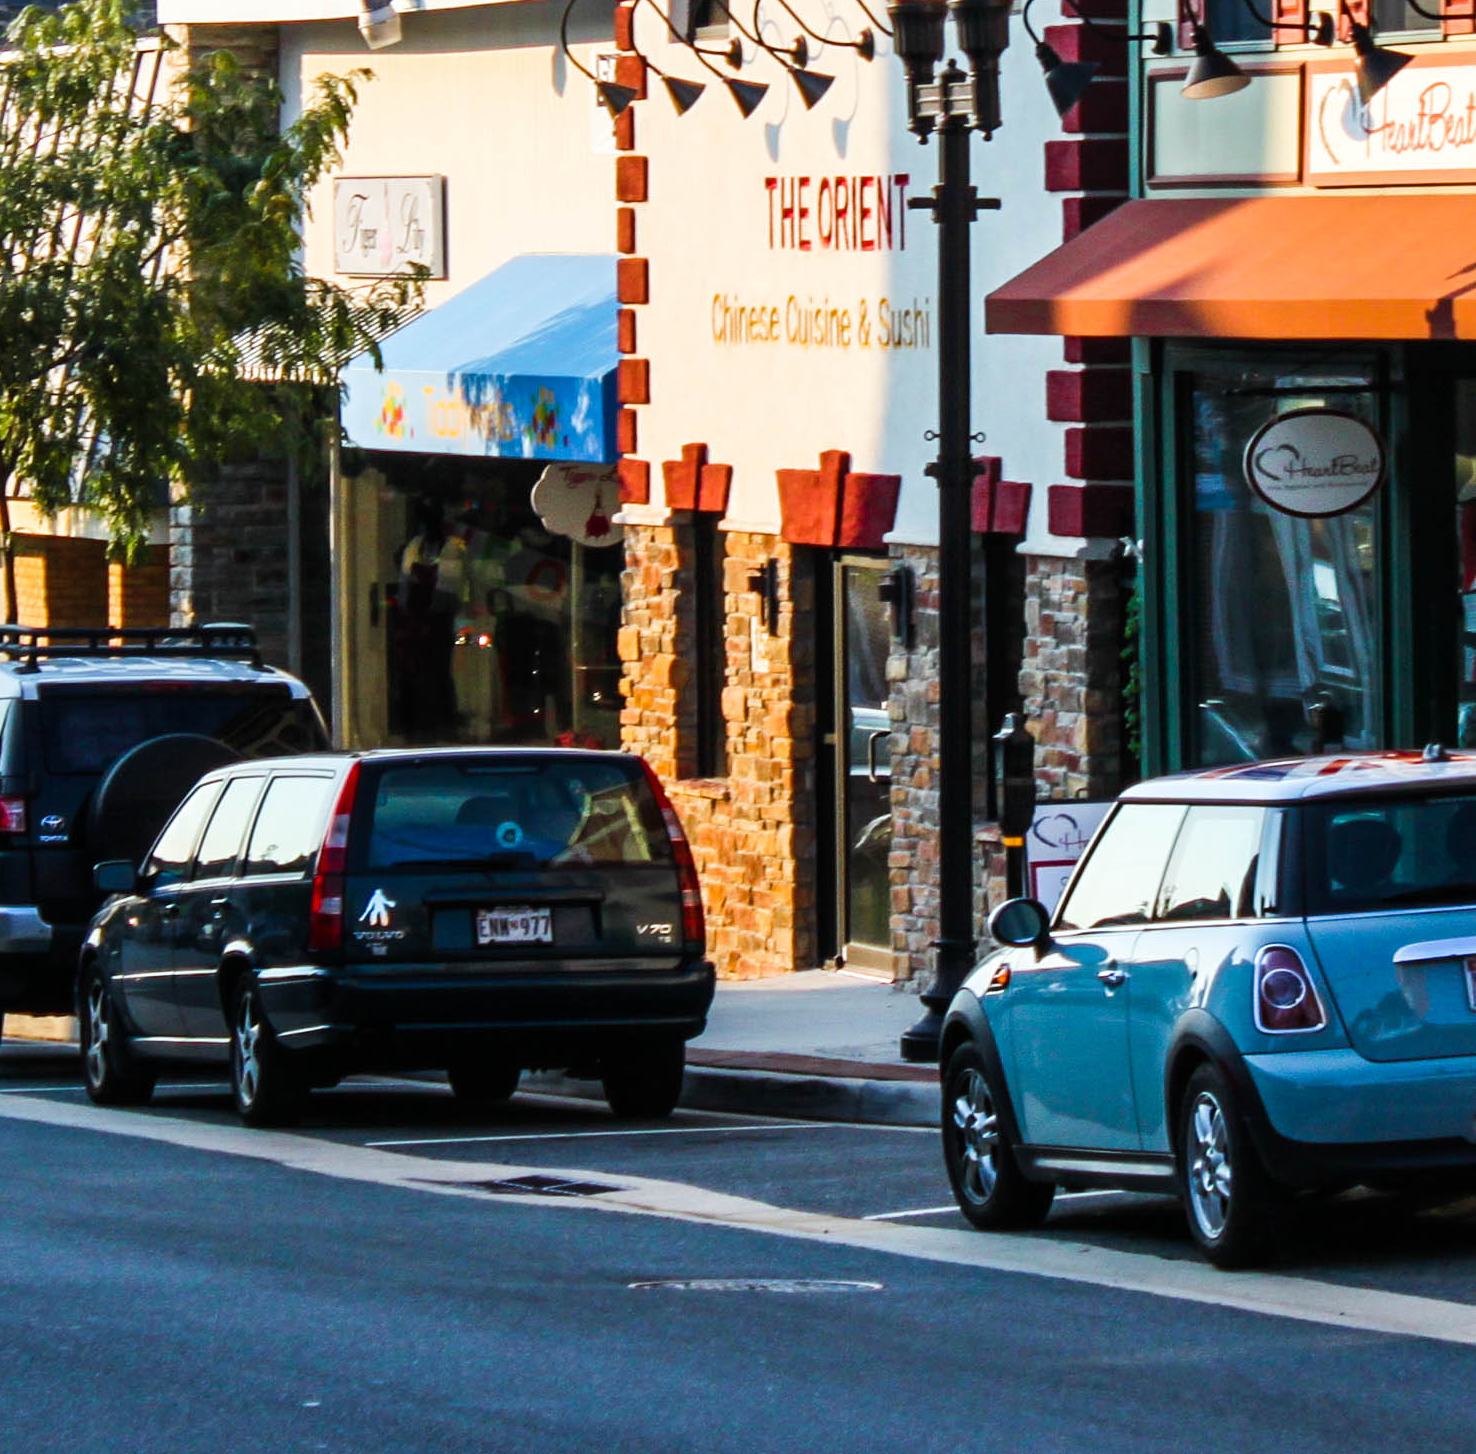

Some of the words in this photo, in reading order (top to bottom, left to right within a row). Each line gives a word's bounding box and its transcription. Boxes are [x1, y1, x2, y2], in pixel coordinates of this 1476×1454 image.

[764, 176, 812, 252] THE
[817, 173, 910, 251] ORIENT
[711, 293, 780, 343] Chinese
[785, 294, 851, 348] Cuisine
[858, 298, 872, 348] &
[877, 297, 931, 350] Sushi
[1284, 453, 1380, 480] HeartBeat
